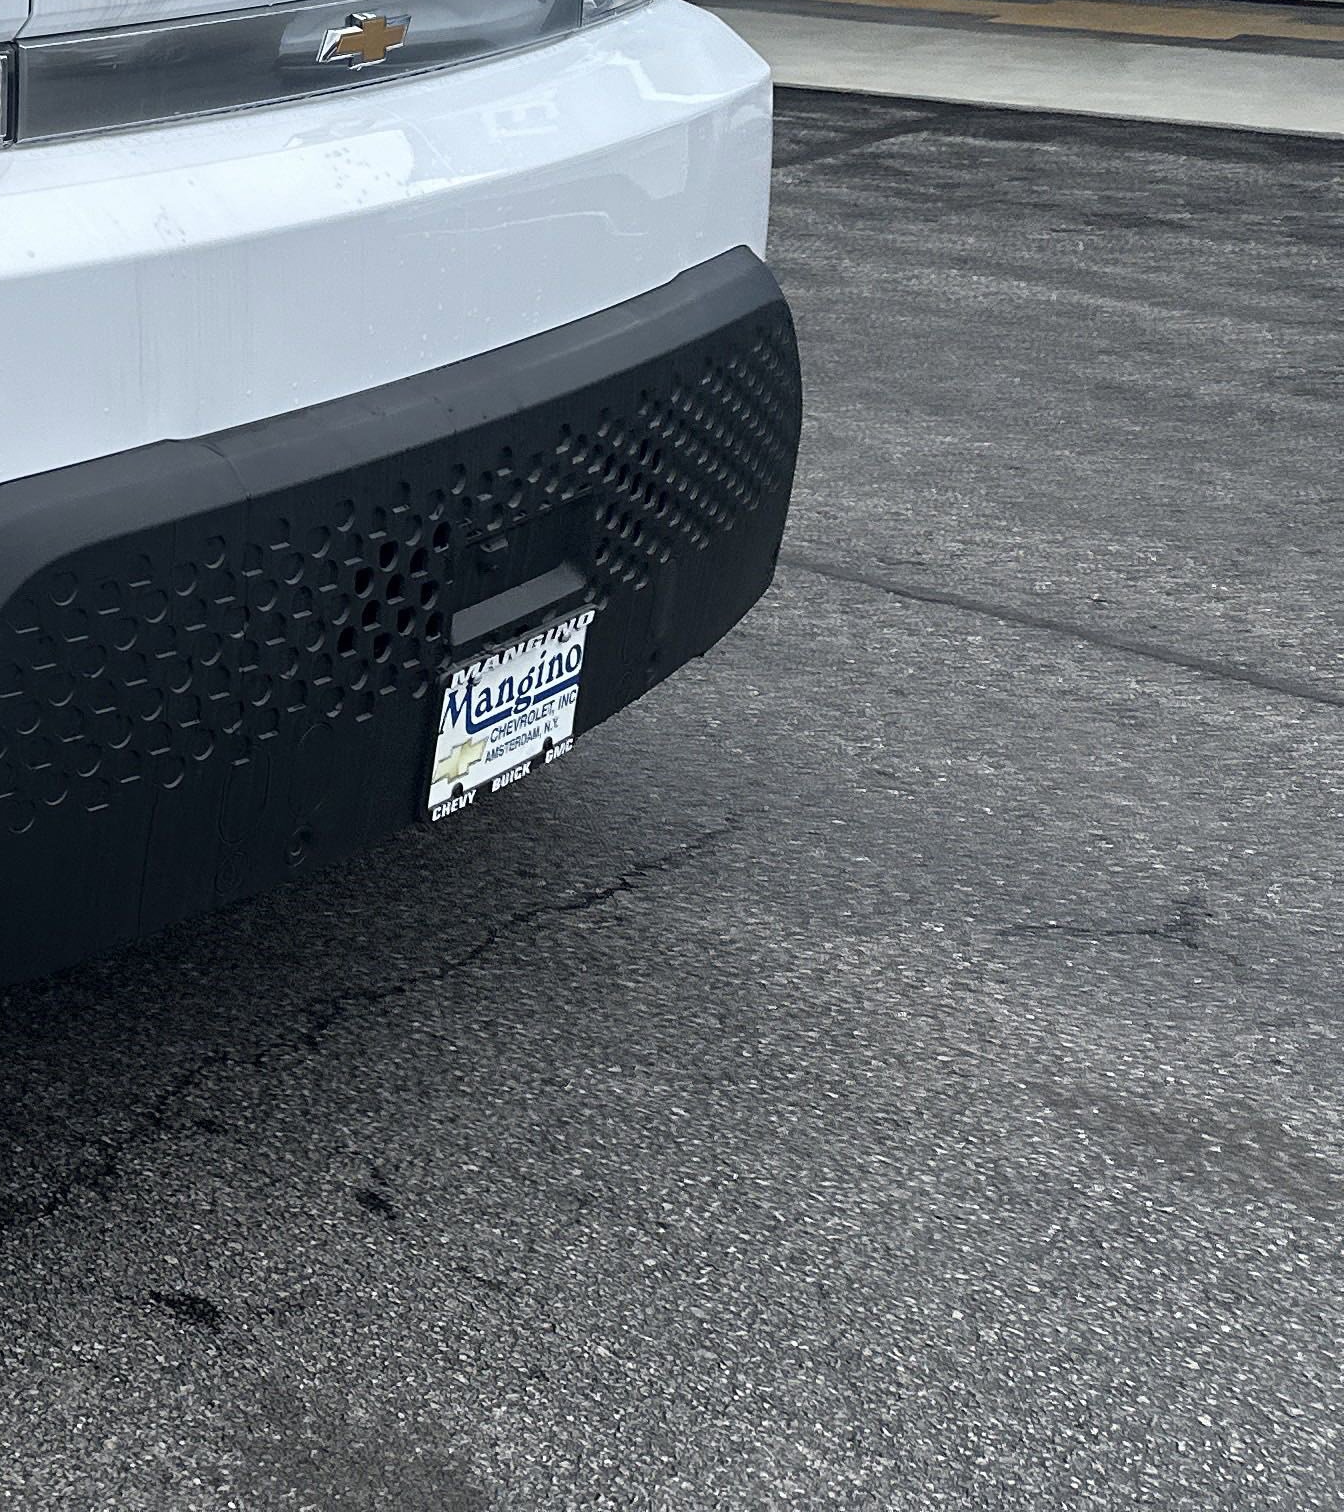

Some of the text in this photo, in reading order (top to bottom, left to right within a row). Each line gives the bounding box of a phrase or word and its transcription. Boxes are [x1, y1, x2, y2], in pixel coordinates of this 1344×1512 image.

[439, 642, 583, 734] Mangino
[450, 610, 596, 688] MANGINO
[431, 738, 574, 822] CHEVY BUICK GMC
